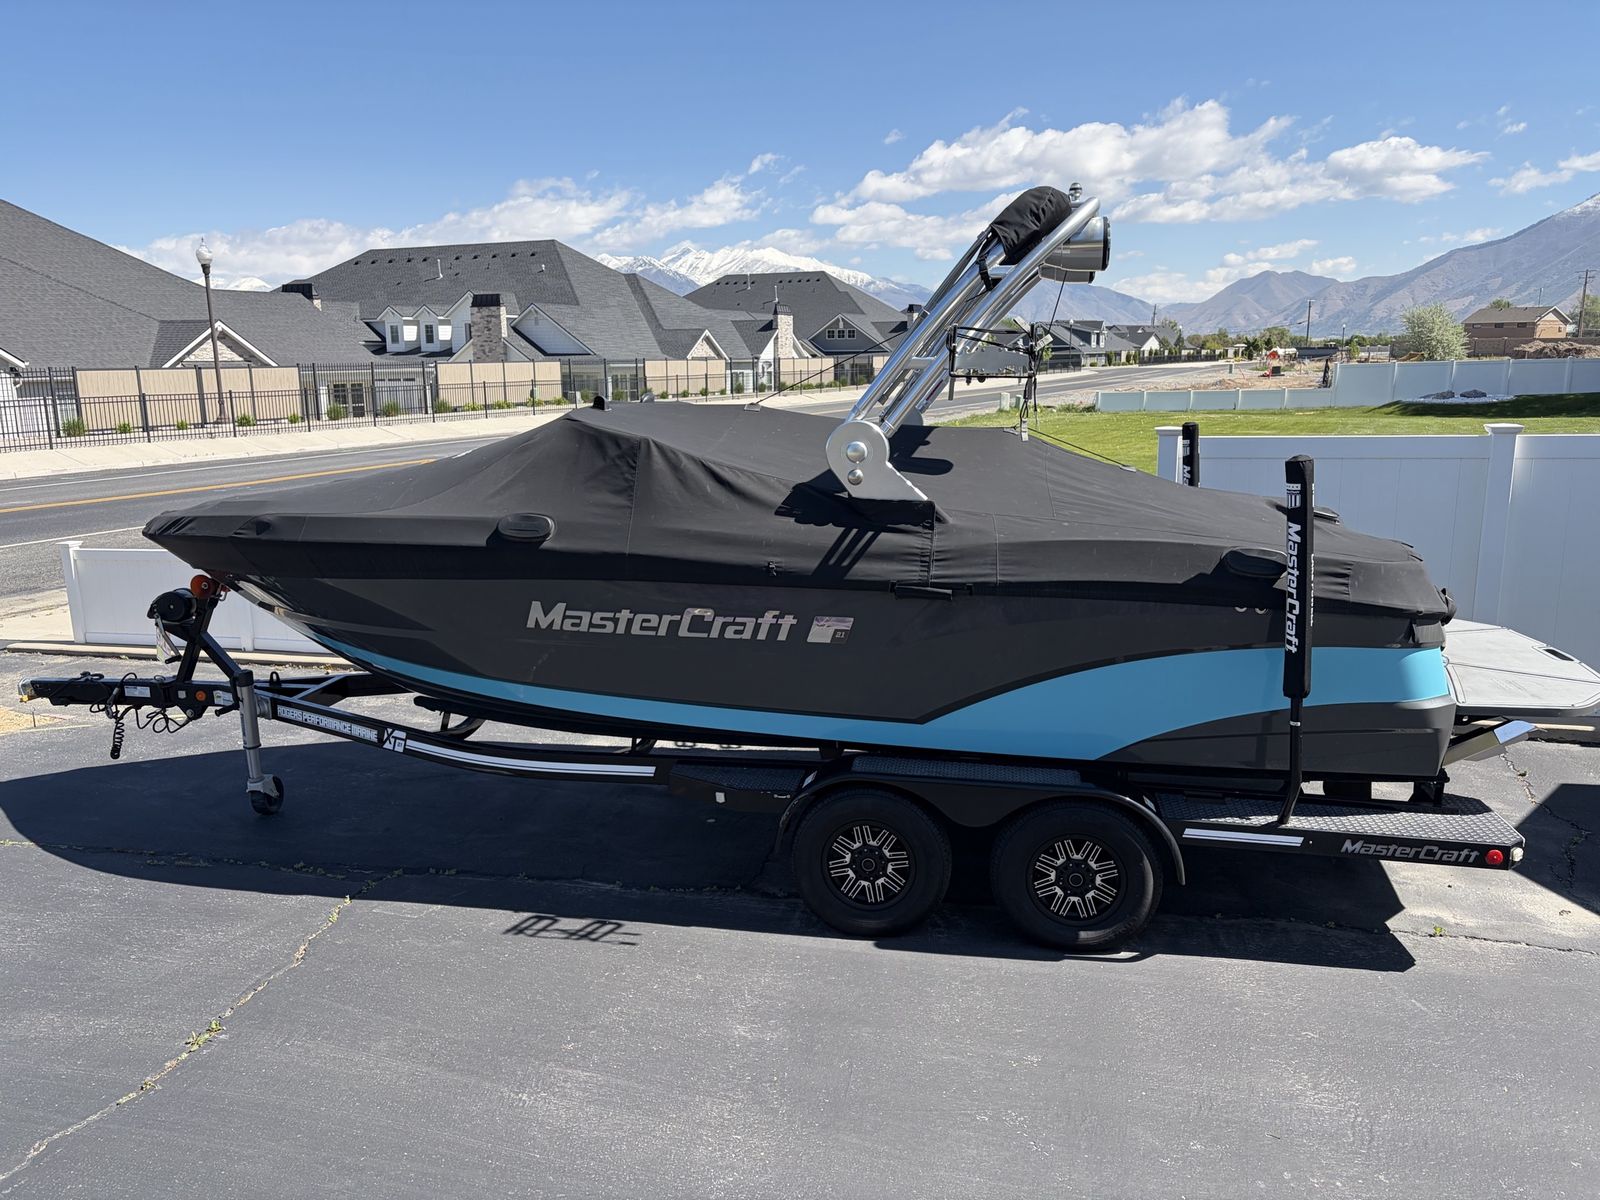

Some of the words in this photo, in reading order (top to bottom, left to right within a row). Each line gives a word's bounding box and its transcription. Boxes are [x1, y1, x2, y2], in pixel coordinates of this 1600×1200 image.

[1285, 521, 1301, 653] MasterCraft
[526, 601, 797, 641] MasterCraft
[277, 705, 302, 722] ROGERS
[303, 712, 351, 735] PERFORMANCE
[352, 724, 378, 742] MARINE
[1341, 839, 1480, 863] MasterCraft
